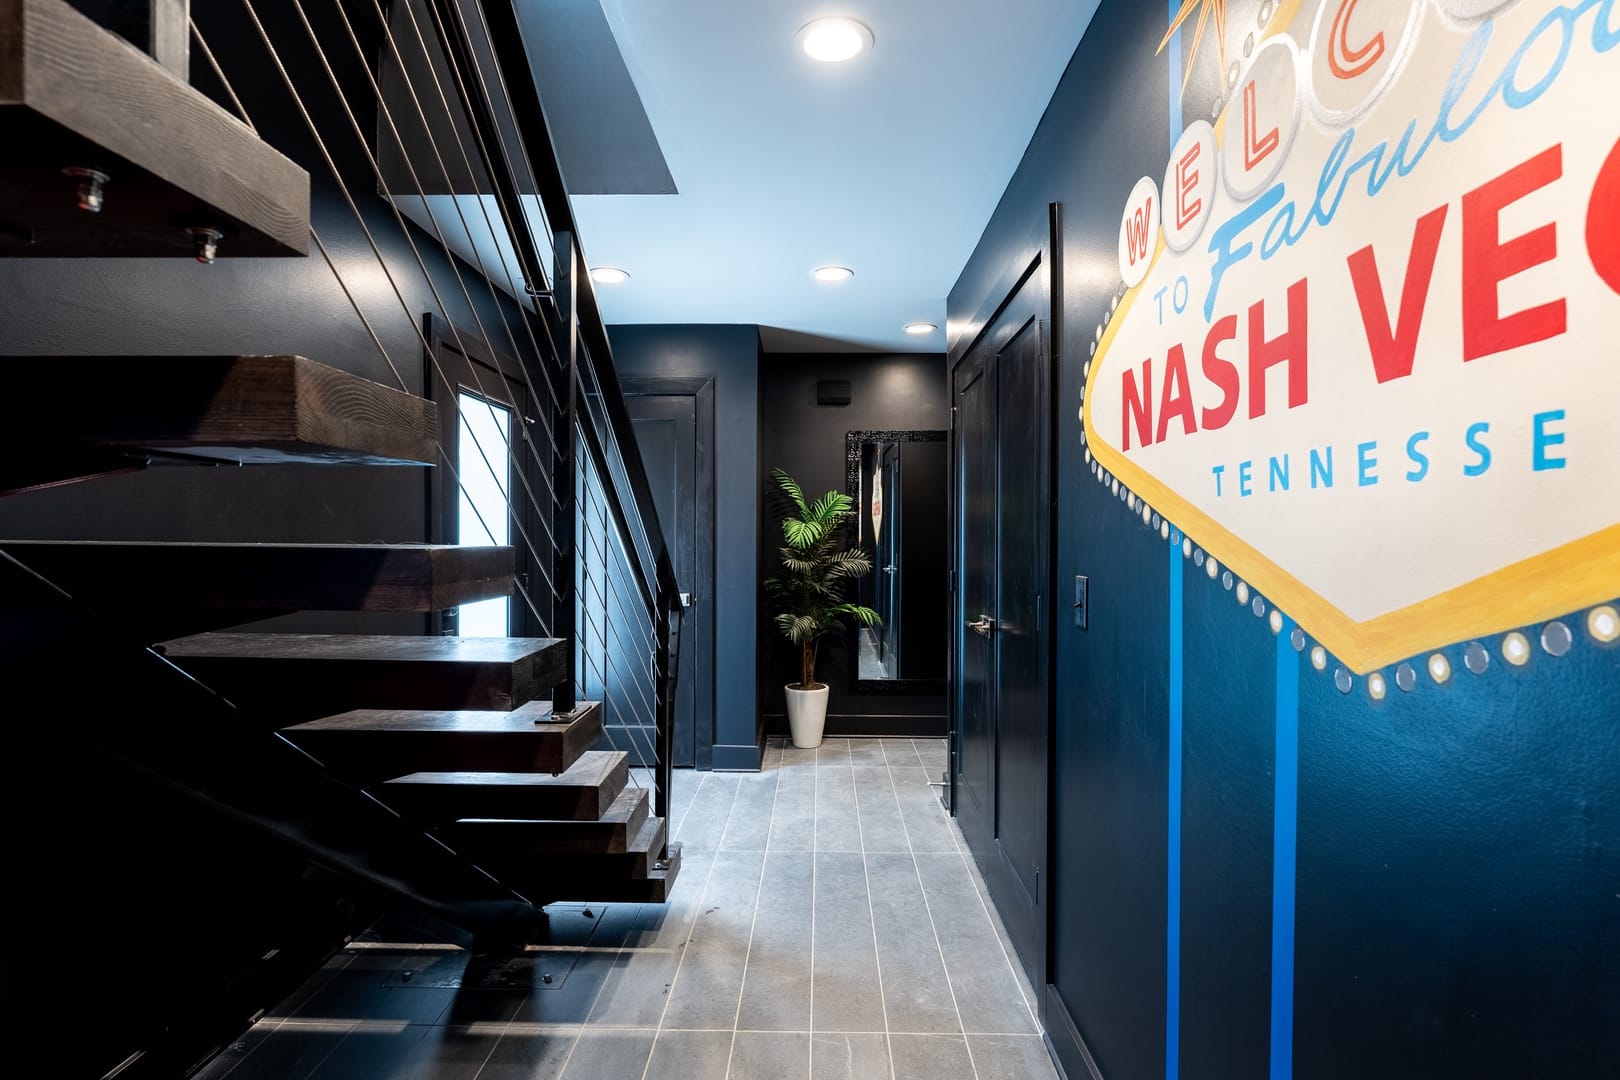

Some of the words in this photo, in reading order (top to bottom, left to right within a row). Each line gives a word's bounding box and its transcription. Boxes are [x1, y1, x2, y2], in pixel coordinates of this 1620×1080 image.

[1154, 275, 1188, 325] TO
[1122, 276, 1308, 452] NASH
[1212, 408, 1567, 497] TENNESSE
